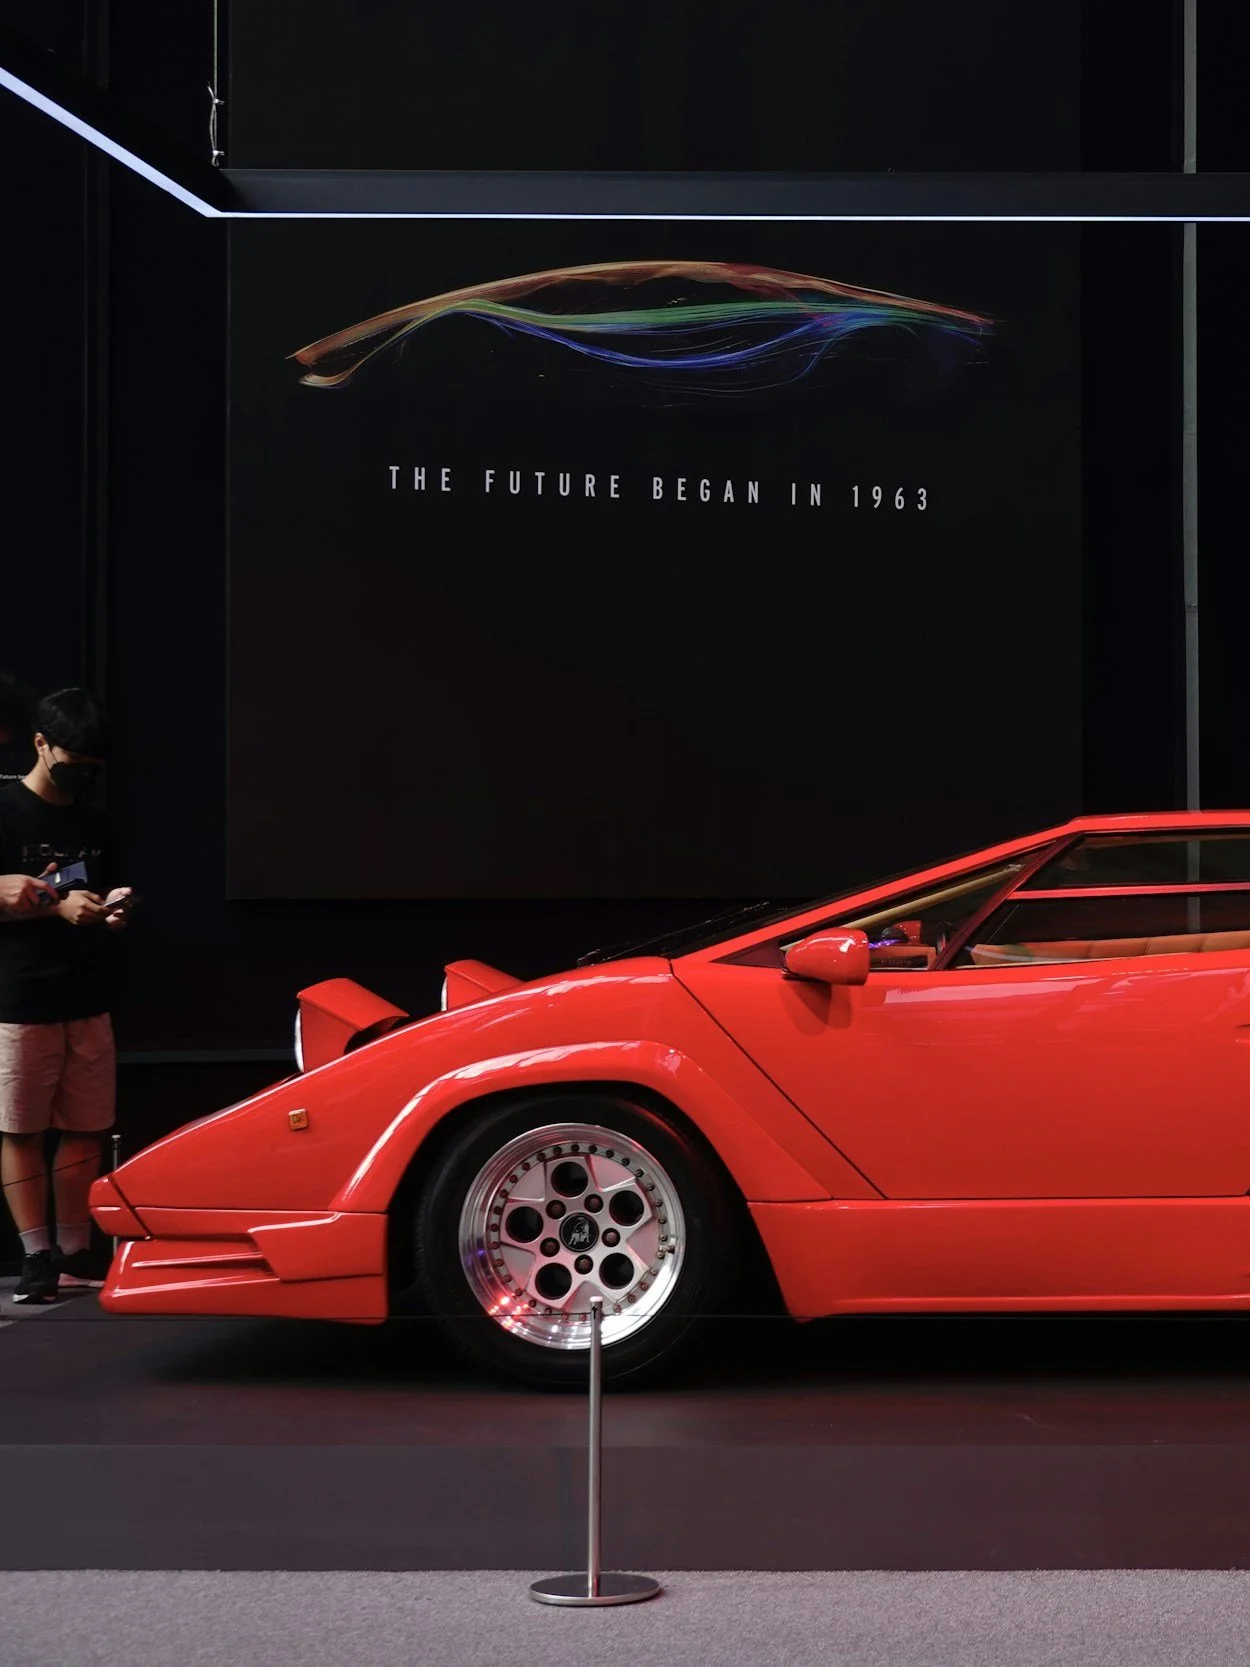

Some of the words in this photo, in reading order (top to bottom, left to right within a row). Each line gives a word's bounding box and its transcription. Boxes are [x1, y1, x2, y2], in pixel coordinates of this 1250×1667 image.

[388, 465, 451, 492] THE
[485, 469, 620, 499] FUTURE
[652, 476, 759, 504] BEGAN
[791, 482, 821, 507] IN
[852, 485, 927, 511] 1963
